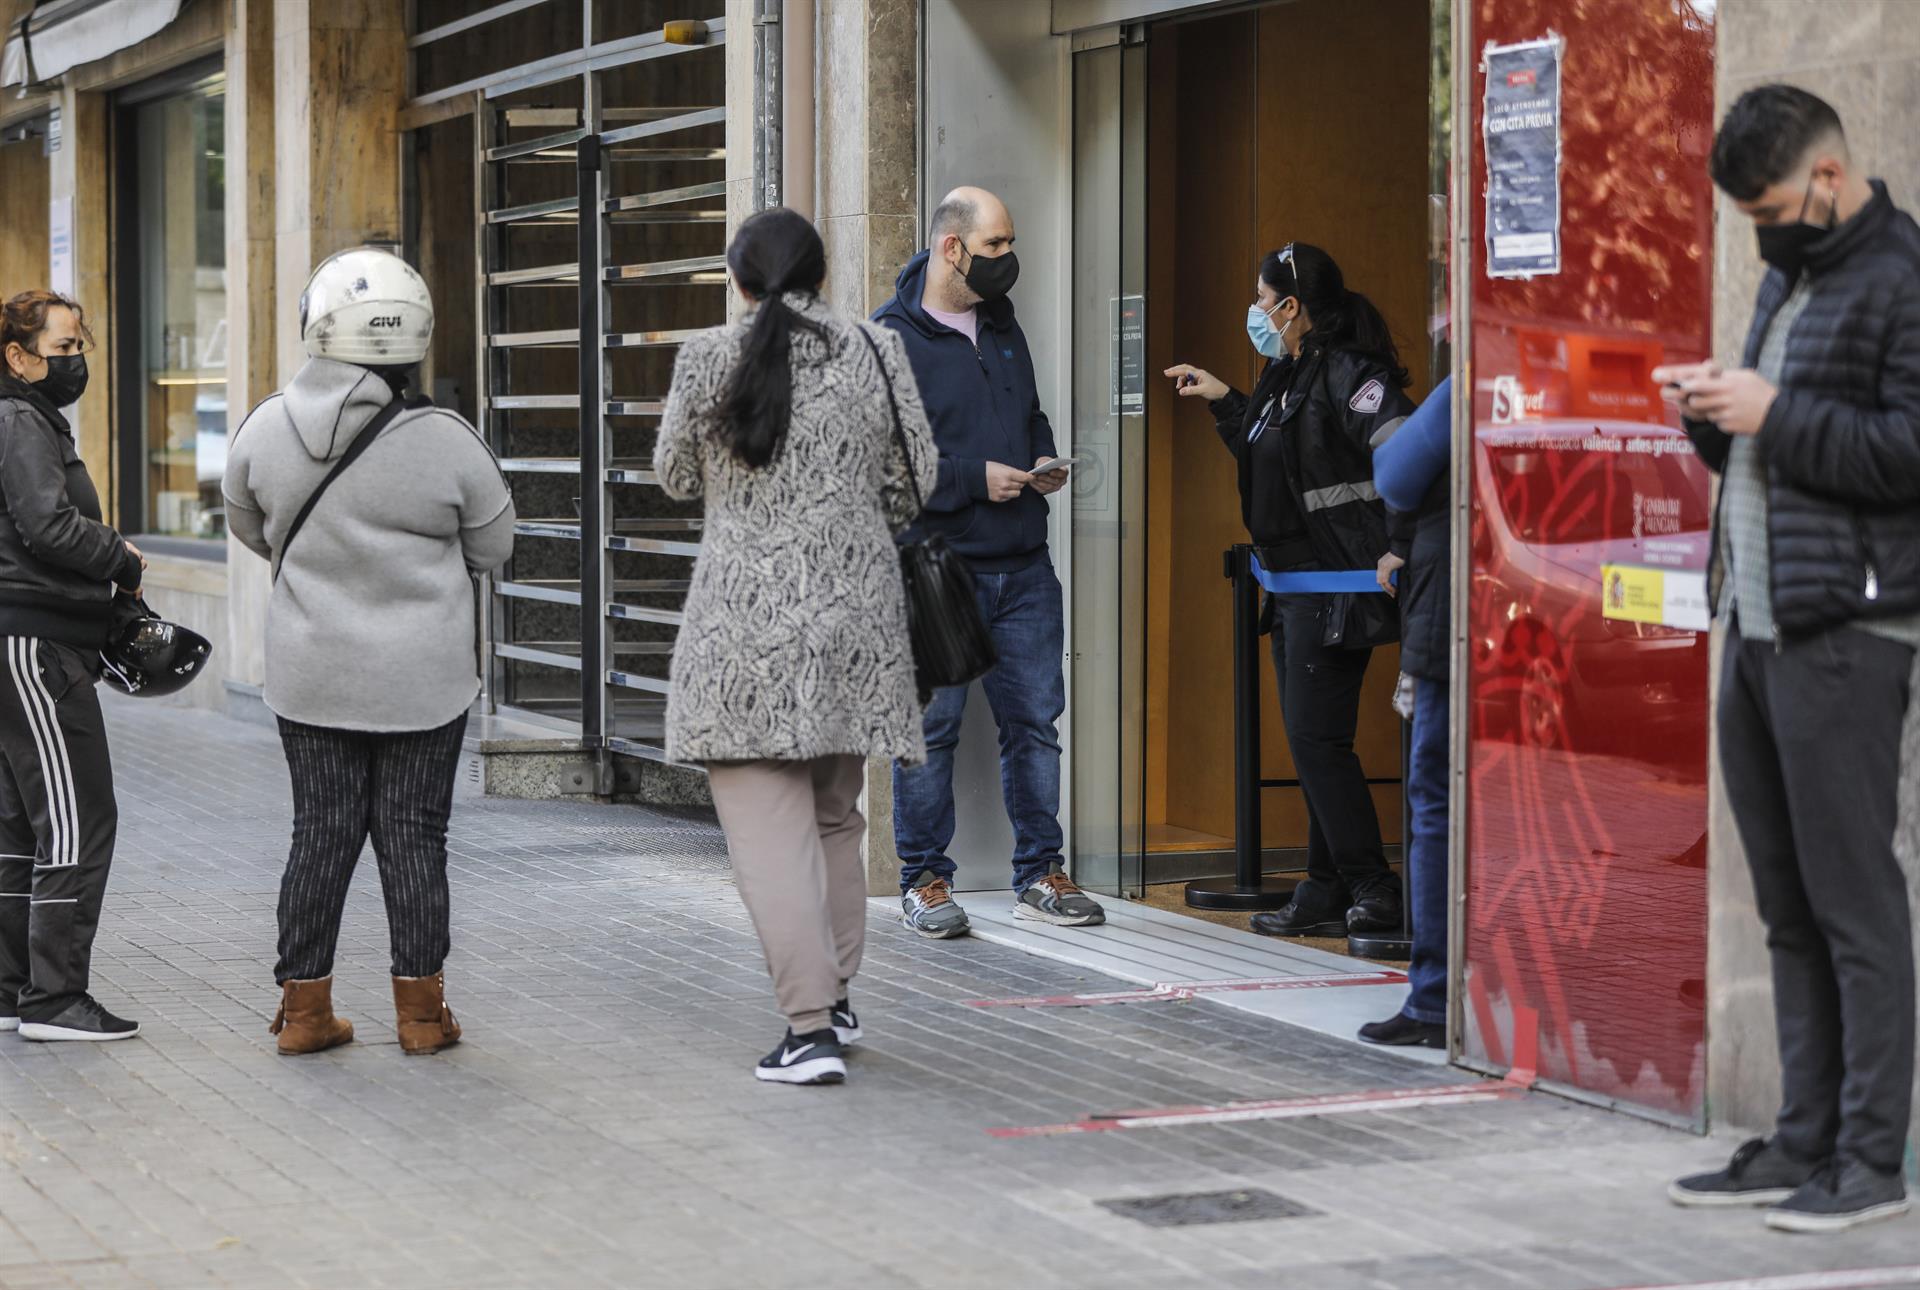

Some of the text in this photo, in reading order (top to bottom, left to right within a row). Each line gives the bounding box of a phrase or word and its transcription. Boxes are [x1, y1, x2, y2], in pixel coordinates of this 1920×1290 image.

[1490, 111, 1552, 132] CON CITA PREVIA
[369, 316, 401, 328] GIVI
